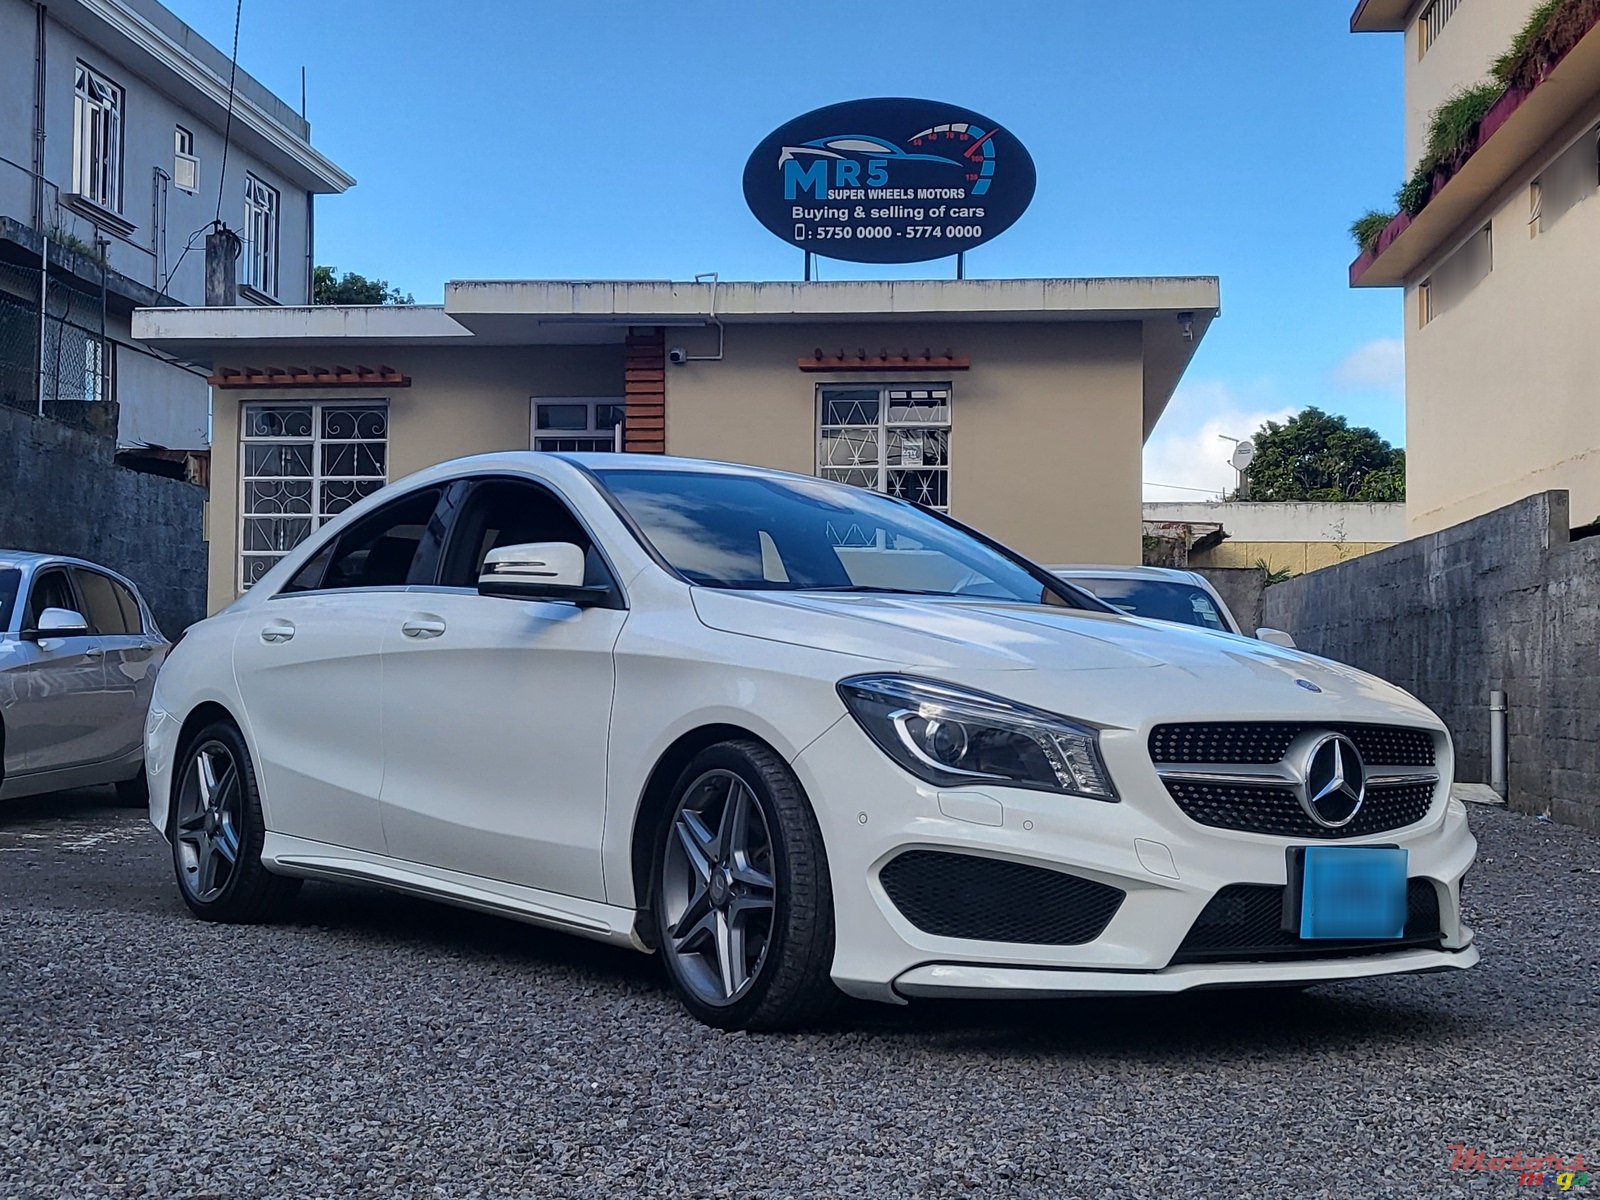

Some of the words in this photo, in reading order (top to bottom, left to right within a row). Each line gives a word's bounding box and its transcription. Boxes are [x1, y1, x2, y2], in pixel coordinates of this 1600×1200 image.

[827, 189, 866, 200] SUPER
[868, 189, 914, 200] WHEELS
[917, 188, 965, 199] MOTORS
[792, 206, 849, 221] Buying
[854, 206, 866, 218] &
[870, 205, 924, 221] selling
[929, 205, 946, 218] of
[950, 207, 985, 218] cars
[816, 226, 852, 239] 5750
[856, 226, 892, 239] 0000
[906, 226, 942, 238] 5774
[946, 225, 982, 238] 0000
